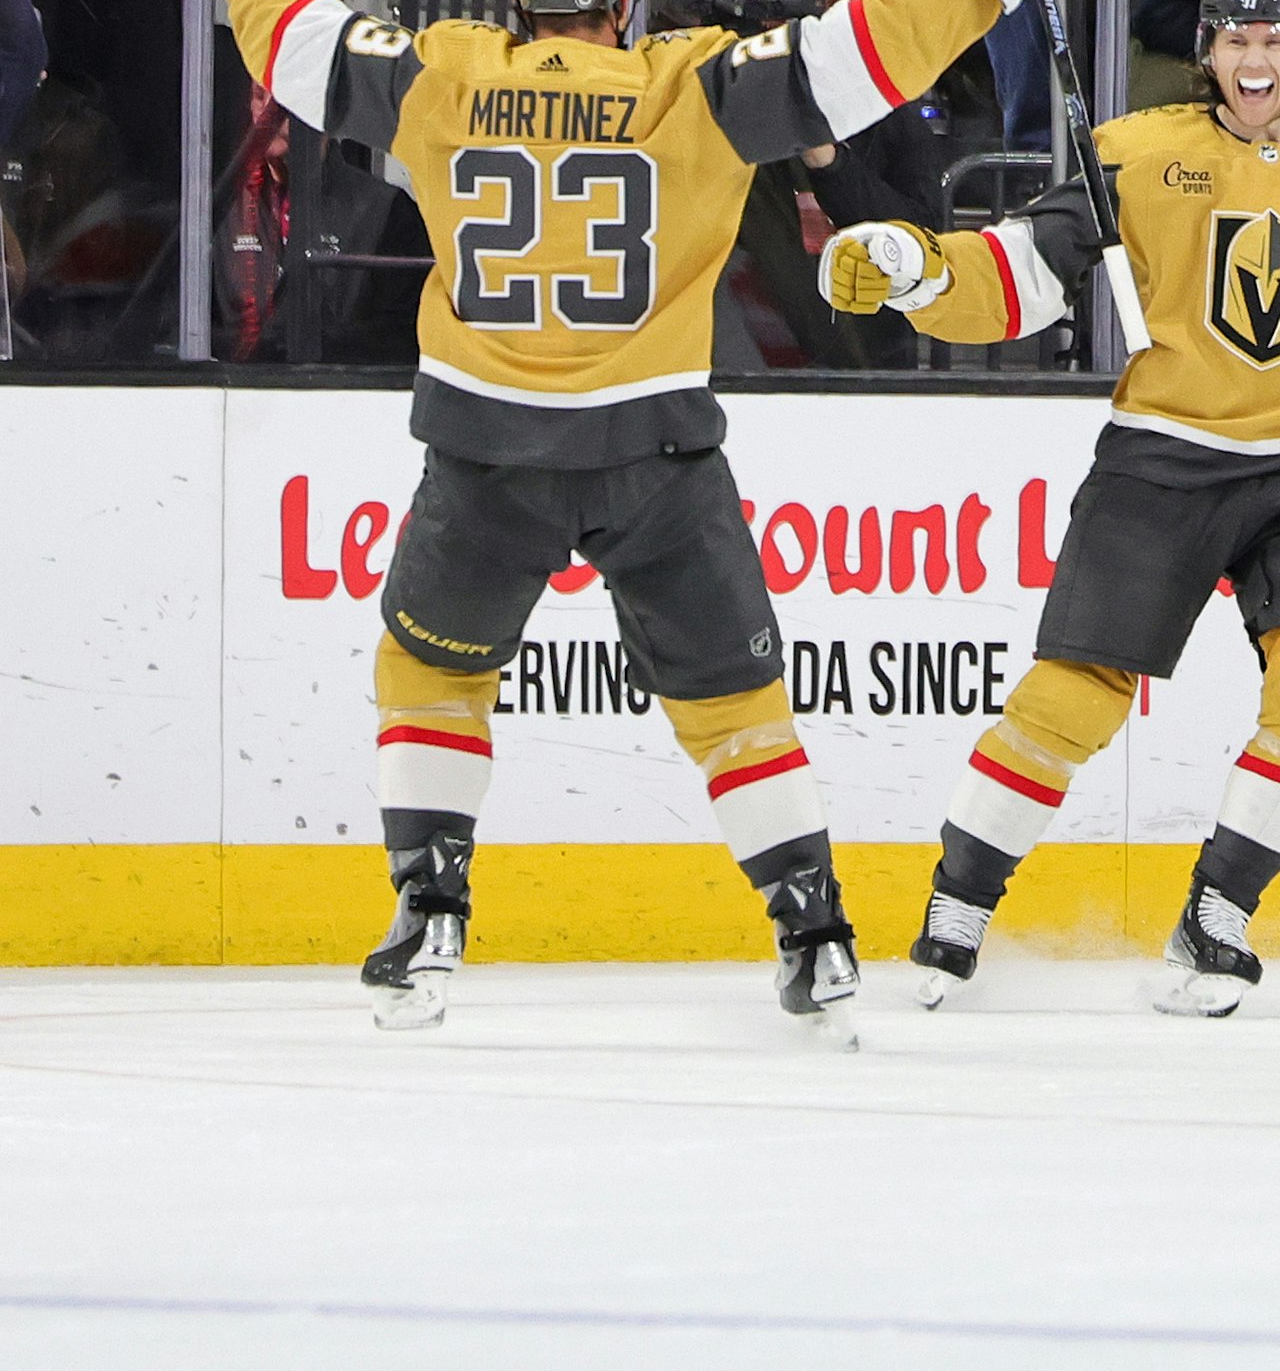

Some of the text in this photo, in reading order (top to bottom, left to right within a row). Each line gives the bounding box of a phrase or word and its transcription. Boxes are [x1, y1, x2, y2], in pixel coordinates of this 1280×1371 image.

[468, 88, 638, 144] MARTINEZ
[1162, 161, 1213, 188] Circa
[1182, 183, 1213, 196] SPORTS
[450, 145, 658, 330] 23
[396, 610, 493, 657] BAUER
[868, 641, 1009, 716] SINCE
